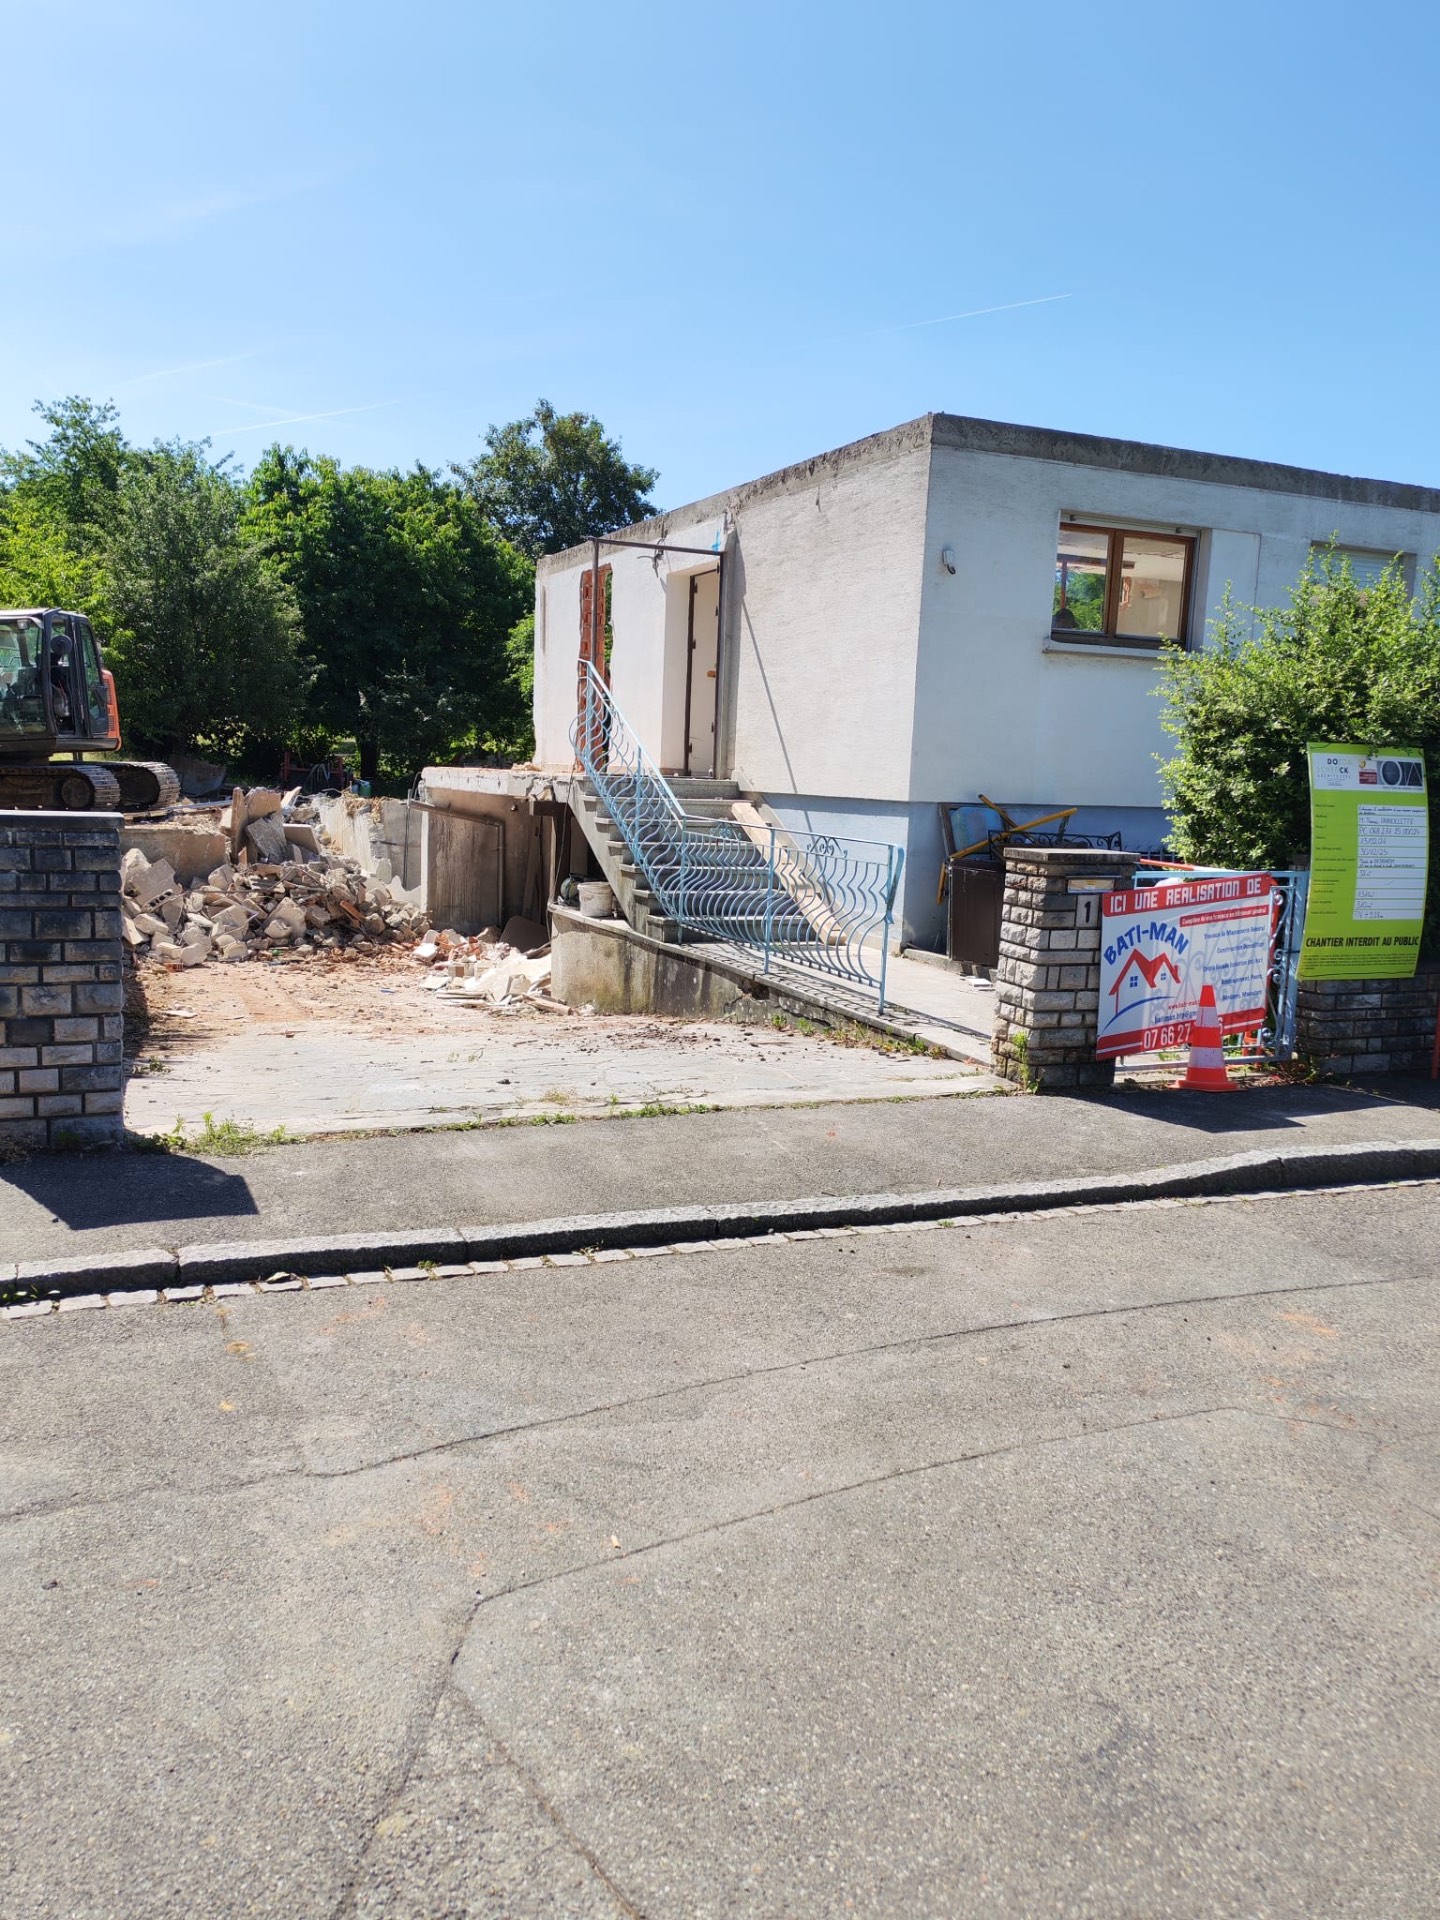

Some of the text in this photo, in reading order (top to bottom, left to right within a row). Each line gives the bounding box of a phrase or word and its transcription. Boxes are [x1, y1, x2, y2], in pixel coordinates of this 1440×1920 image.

[1110, 878, 1262, 913] ICI UNE REALISATION DE
[1084, 901, 1091, 923] 1
[1103, 921, 1190, 966] BATI-MAN
[1305, 936, 1420, 948] CHANTIER INTERDIT AU PUBLIC
[1143, 1029, 1158, 1049] 07
[1160, 1025, 1175, 1046] 66
[1177, 1022, 1191, 1043] 27
